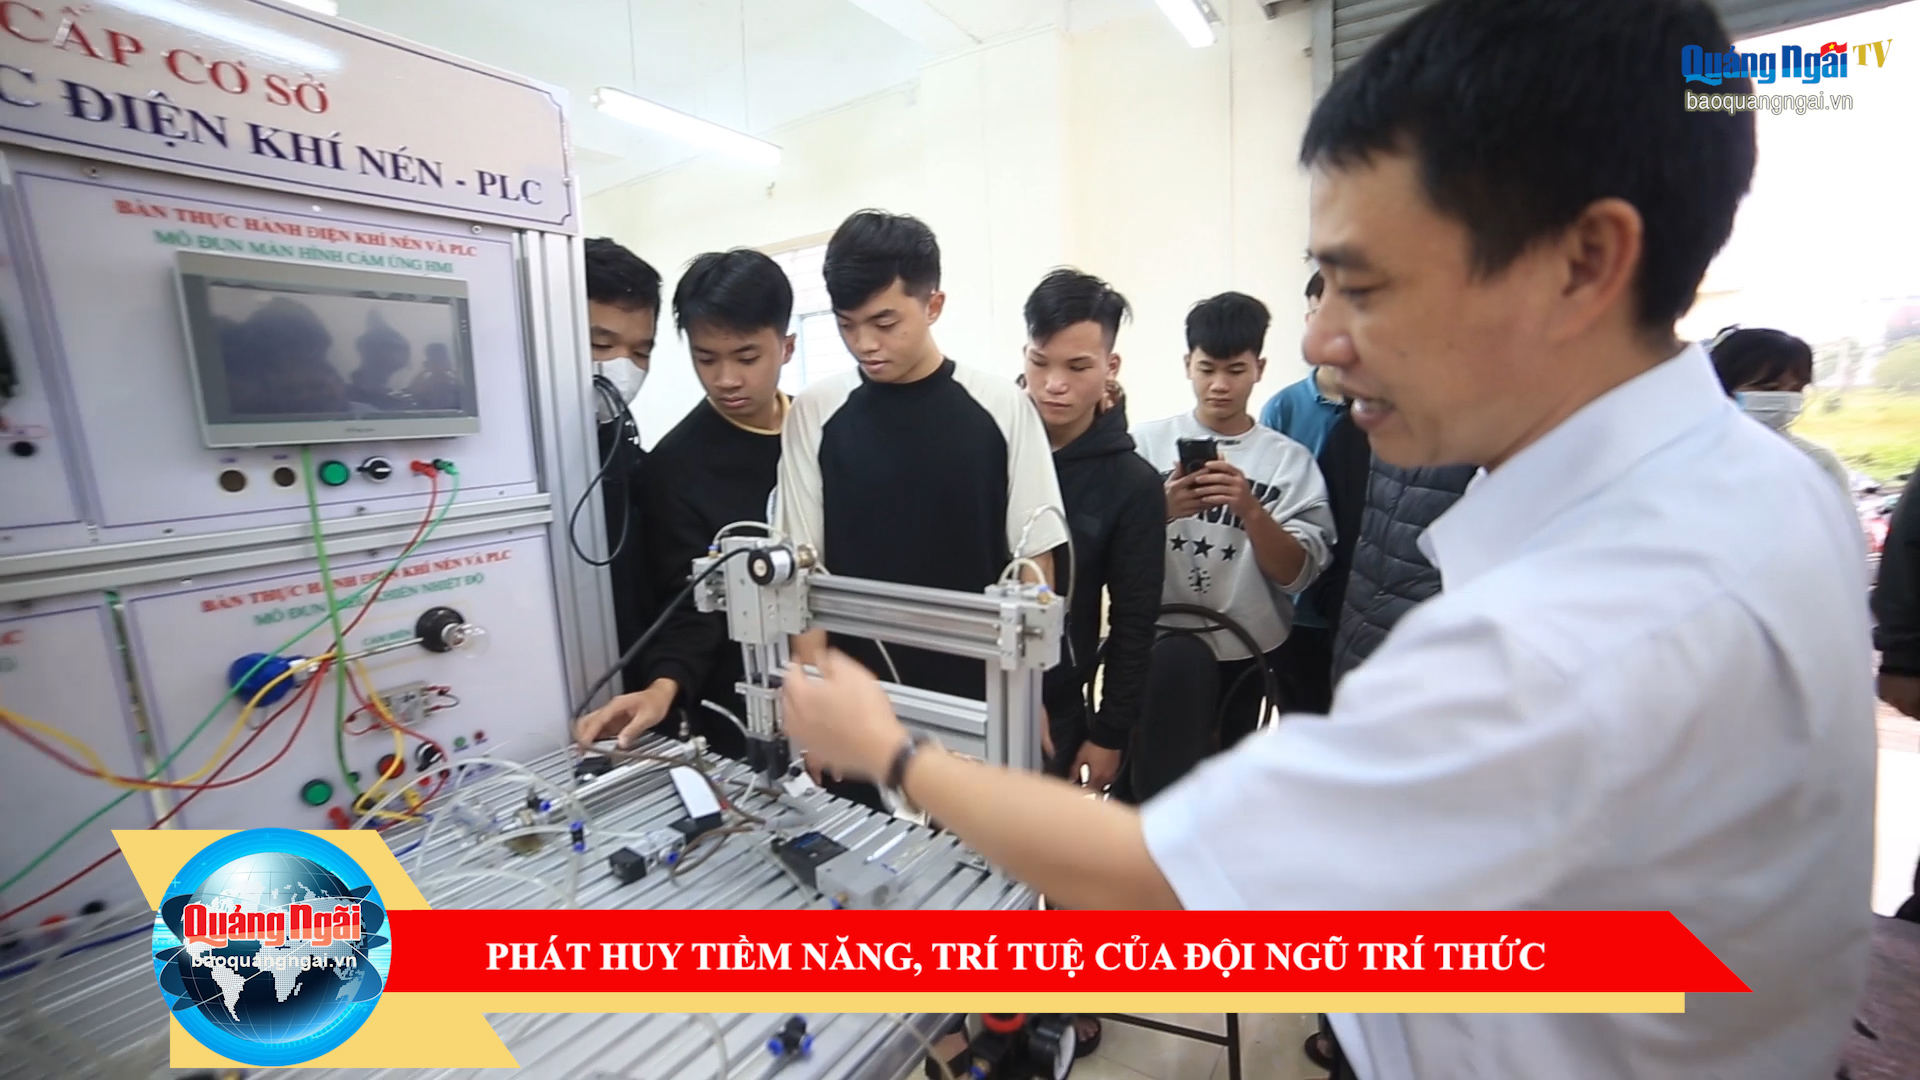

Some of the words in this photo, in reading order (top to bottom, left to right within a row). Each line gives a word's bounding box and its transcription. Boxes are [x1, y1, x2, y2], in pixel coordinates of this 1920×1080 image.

[0, 1, 144, 67] CẤP
[163, 47, 249, 95] CƠ
[266, 71, 330, 115] SỞ
[60, 79, 229, 150] ĐIỆN
[246, 122, 346, 170] KHÍ
[357, 145, 444, 188] NÉN
[476, 168, 544, 206] PLC
[449, 243, 478, 257] PLC
